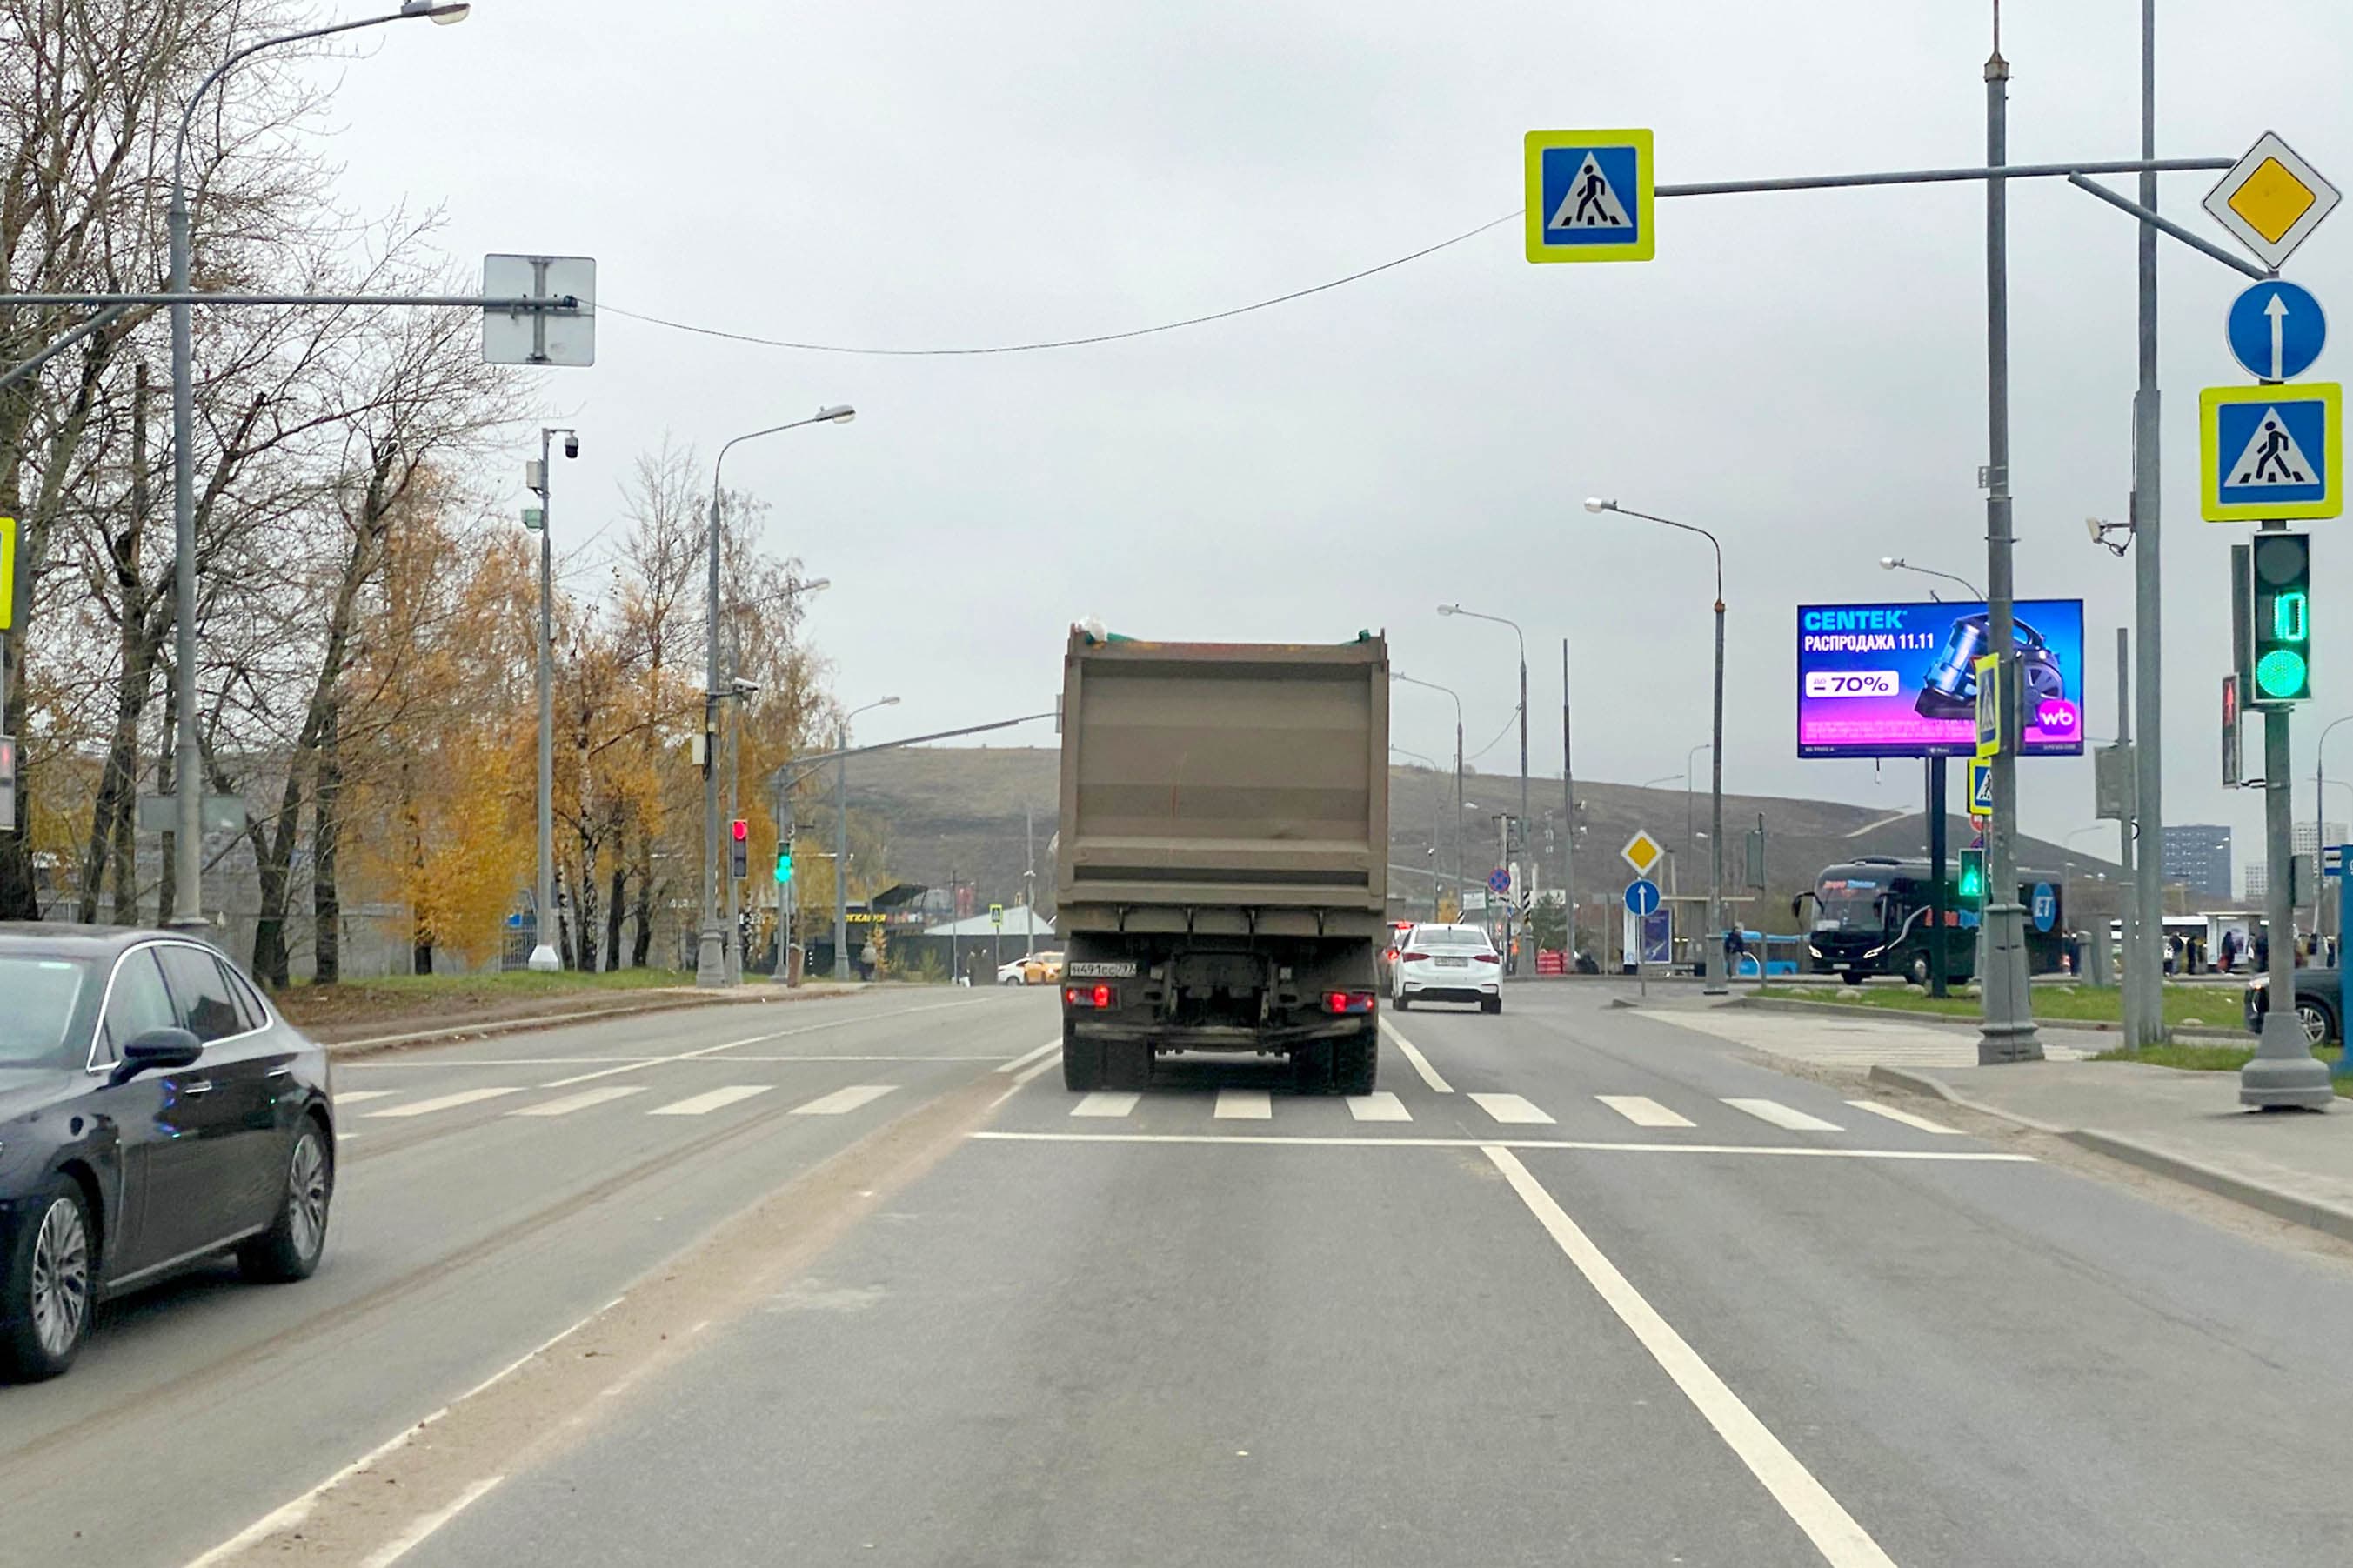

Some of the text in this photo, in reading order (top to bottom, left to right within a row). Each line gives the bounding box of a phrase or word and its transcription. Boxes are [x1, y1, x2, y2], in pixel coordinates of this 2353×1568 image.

[1804, 611, 1903, 631] CENTEK
[1804, 632, 1934, 652] РАСПРОДАЖА 11.11
[2041, 708, 2073, 726] wb
